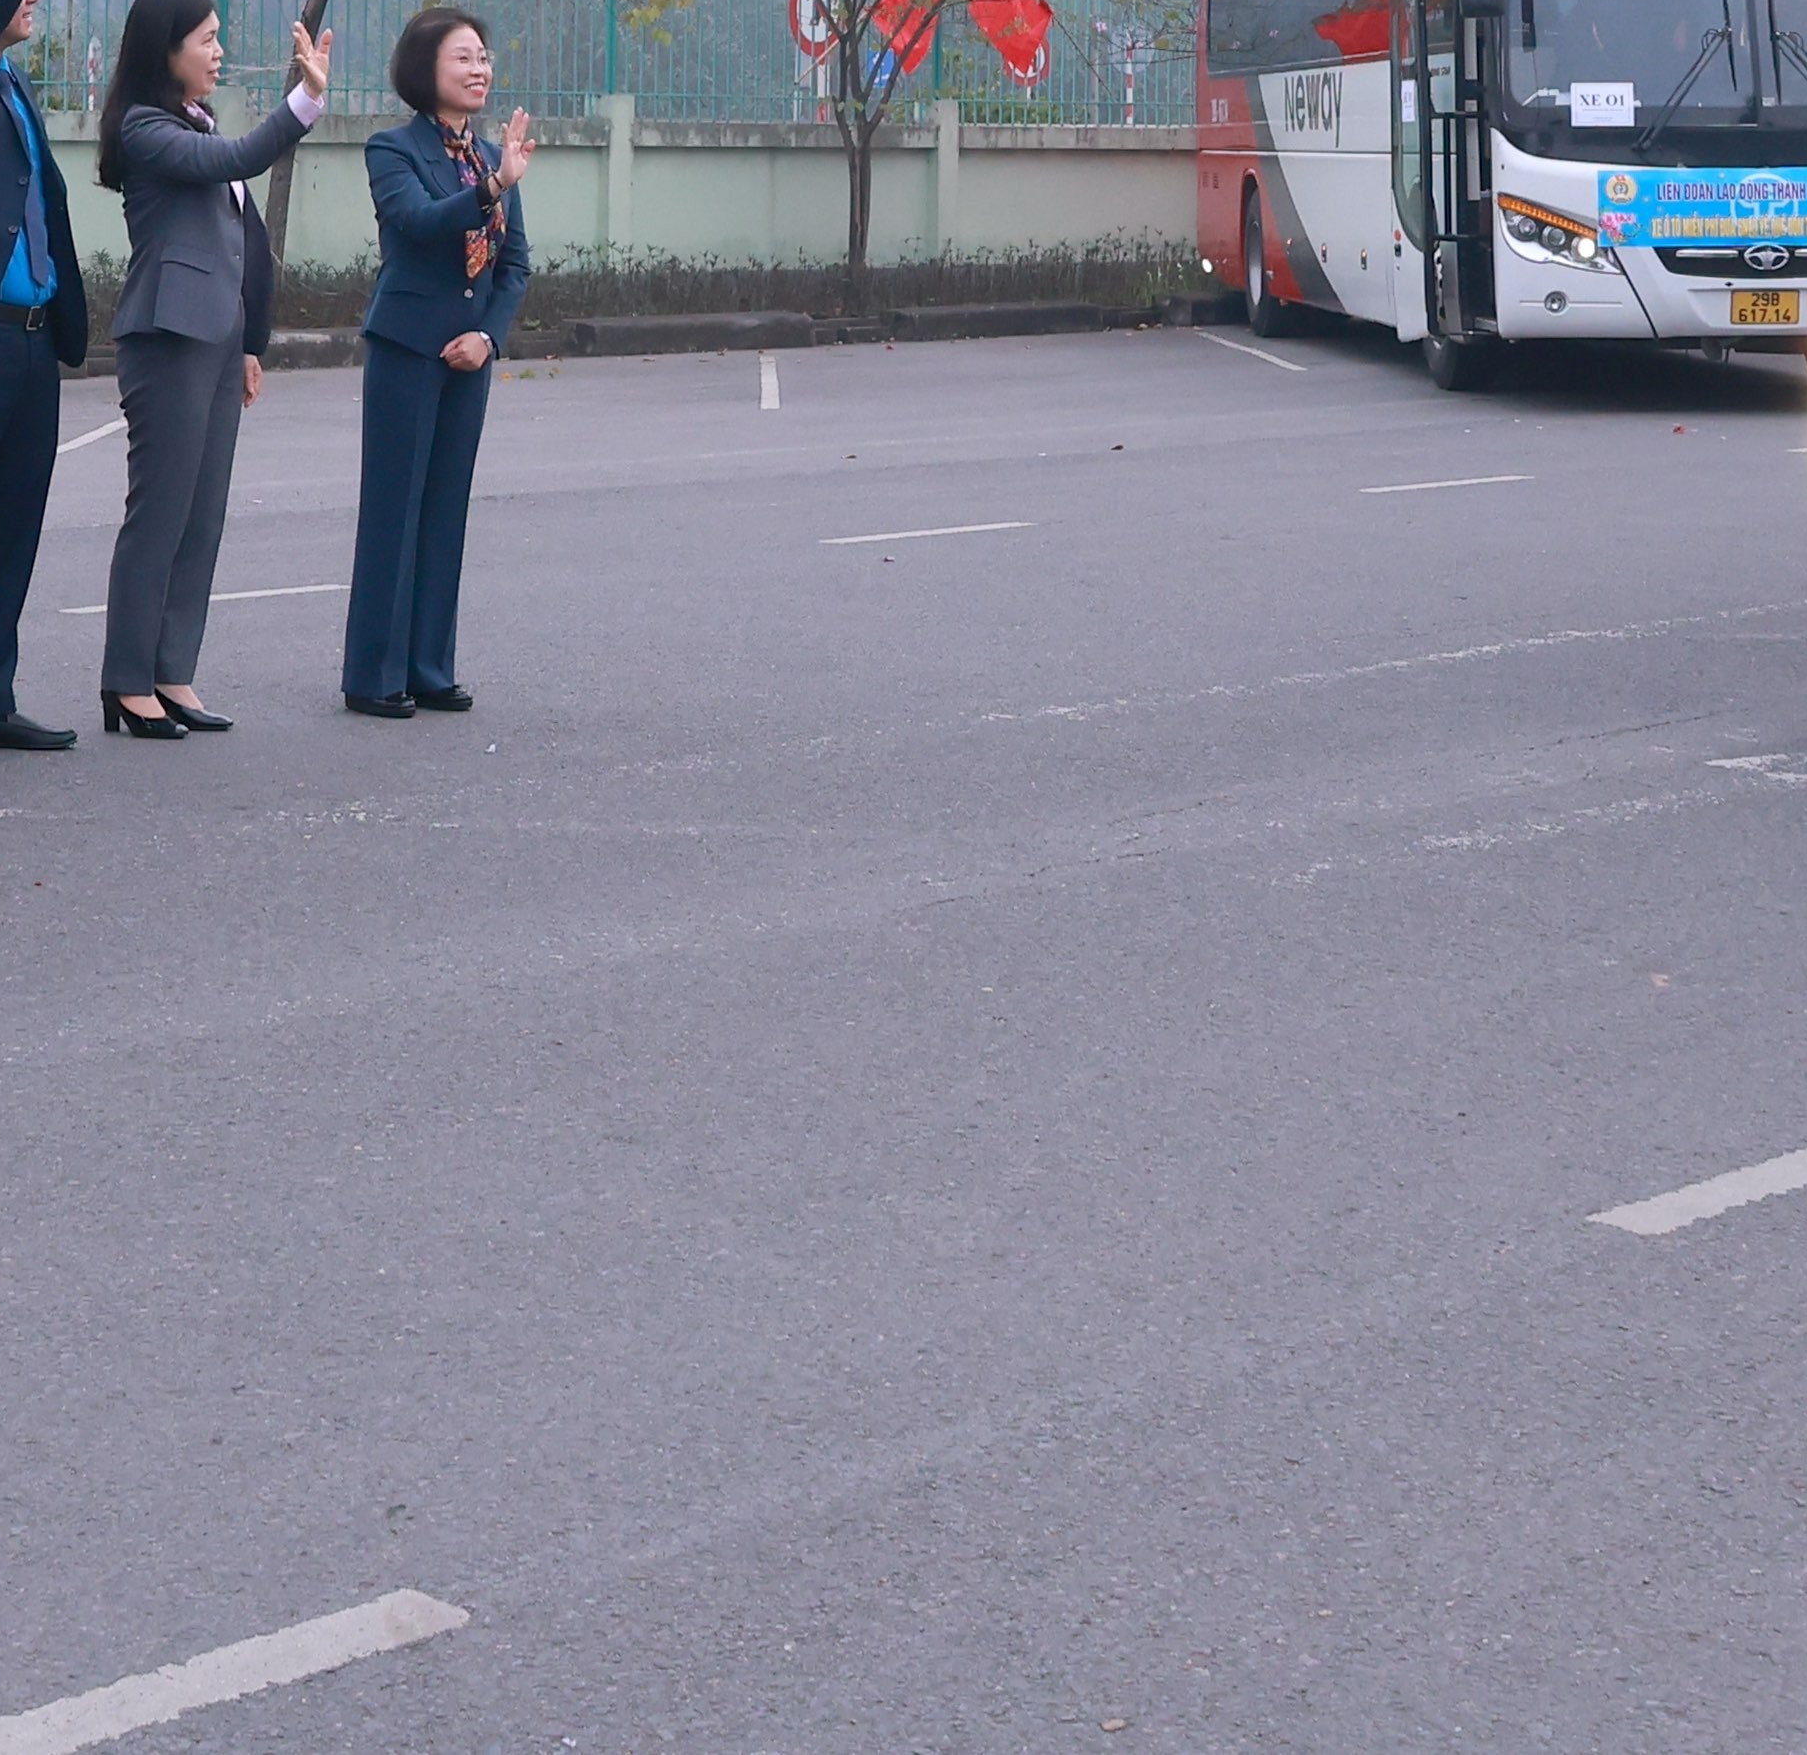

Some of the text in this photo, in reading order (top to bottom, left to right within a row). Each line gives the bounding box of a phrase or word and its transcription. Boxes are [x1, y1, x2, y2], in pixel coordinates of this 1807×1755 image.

[1580, 94, 1601, 106] XE
[1717, 183, 1736, 201] LAO
[1752, 293, 1780, 307] 29B
[1739, 308, 1792, 323] 617.14
